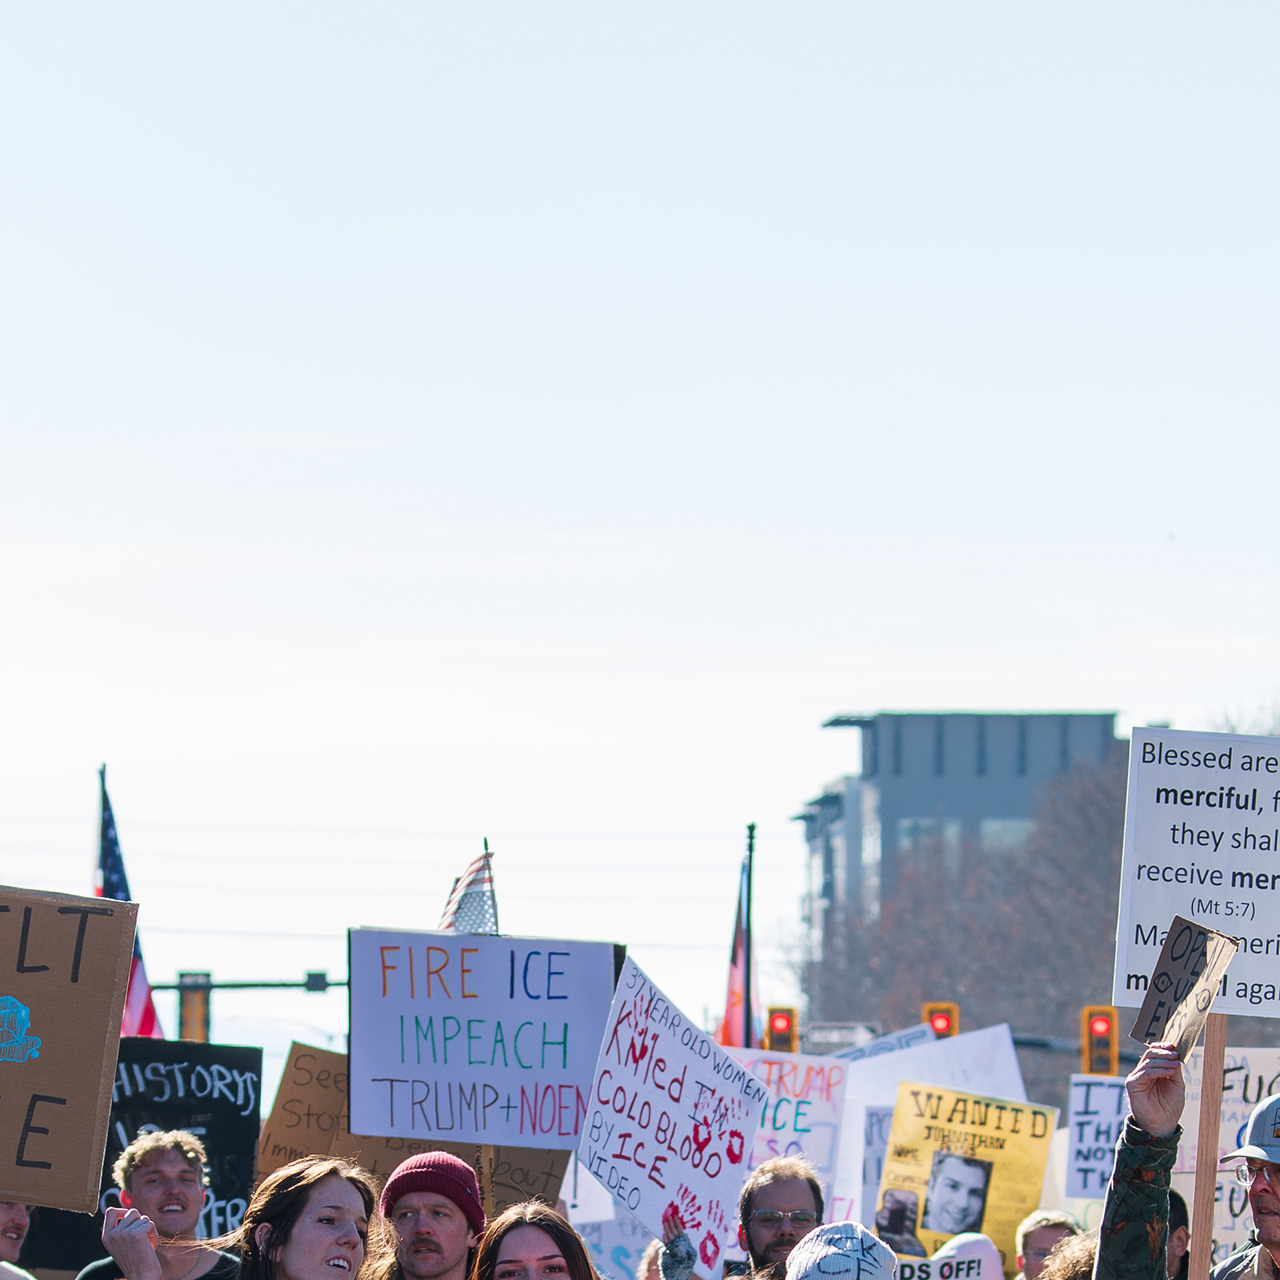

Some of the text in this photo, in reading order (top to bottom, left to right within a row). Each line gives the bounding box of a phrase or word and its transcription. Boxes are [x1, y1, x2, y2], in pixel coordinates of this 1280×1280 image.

[1142, 742, 1233, 770] Blessed
[1241, 754, 1279, 774] are
[1156, 786, 1264, 816] merciful,
[1170, 822, 1225, 852] they
[1136, 862, 1224, 887] receive
[1190, 897, 1256, 921] (Mt 5:7)
[380, 945, 571, 1000] FIRE ICE
[399, 1014, 569, 1070] IMPEACH
[625, 966, 767, 1103] 37 YEAR OLD WOMEN
[762, 1059, 845, 1103] TRUMP
[596, 1069, 723, 1179] COLD BLOOD
[760, 1097, 812, 1133] ICE
[910, 1090, 1049, 1139] WANTED
[588, 1110, 615, 1150] BY
[612, 1132, 669, 1189] ICE
[587, 1146, 641, 1211] VIDEO
